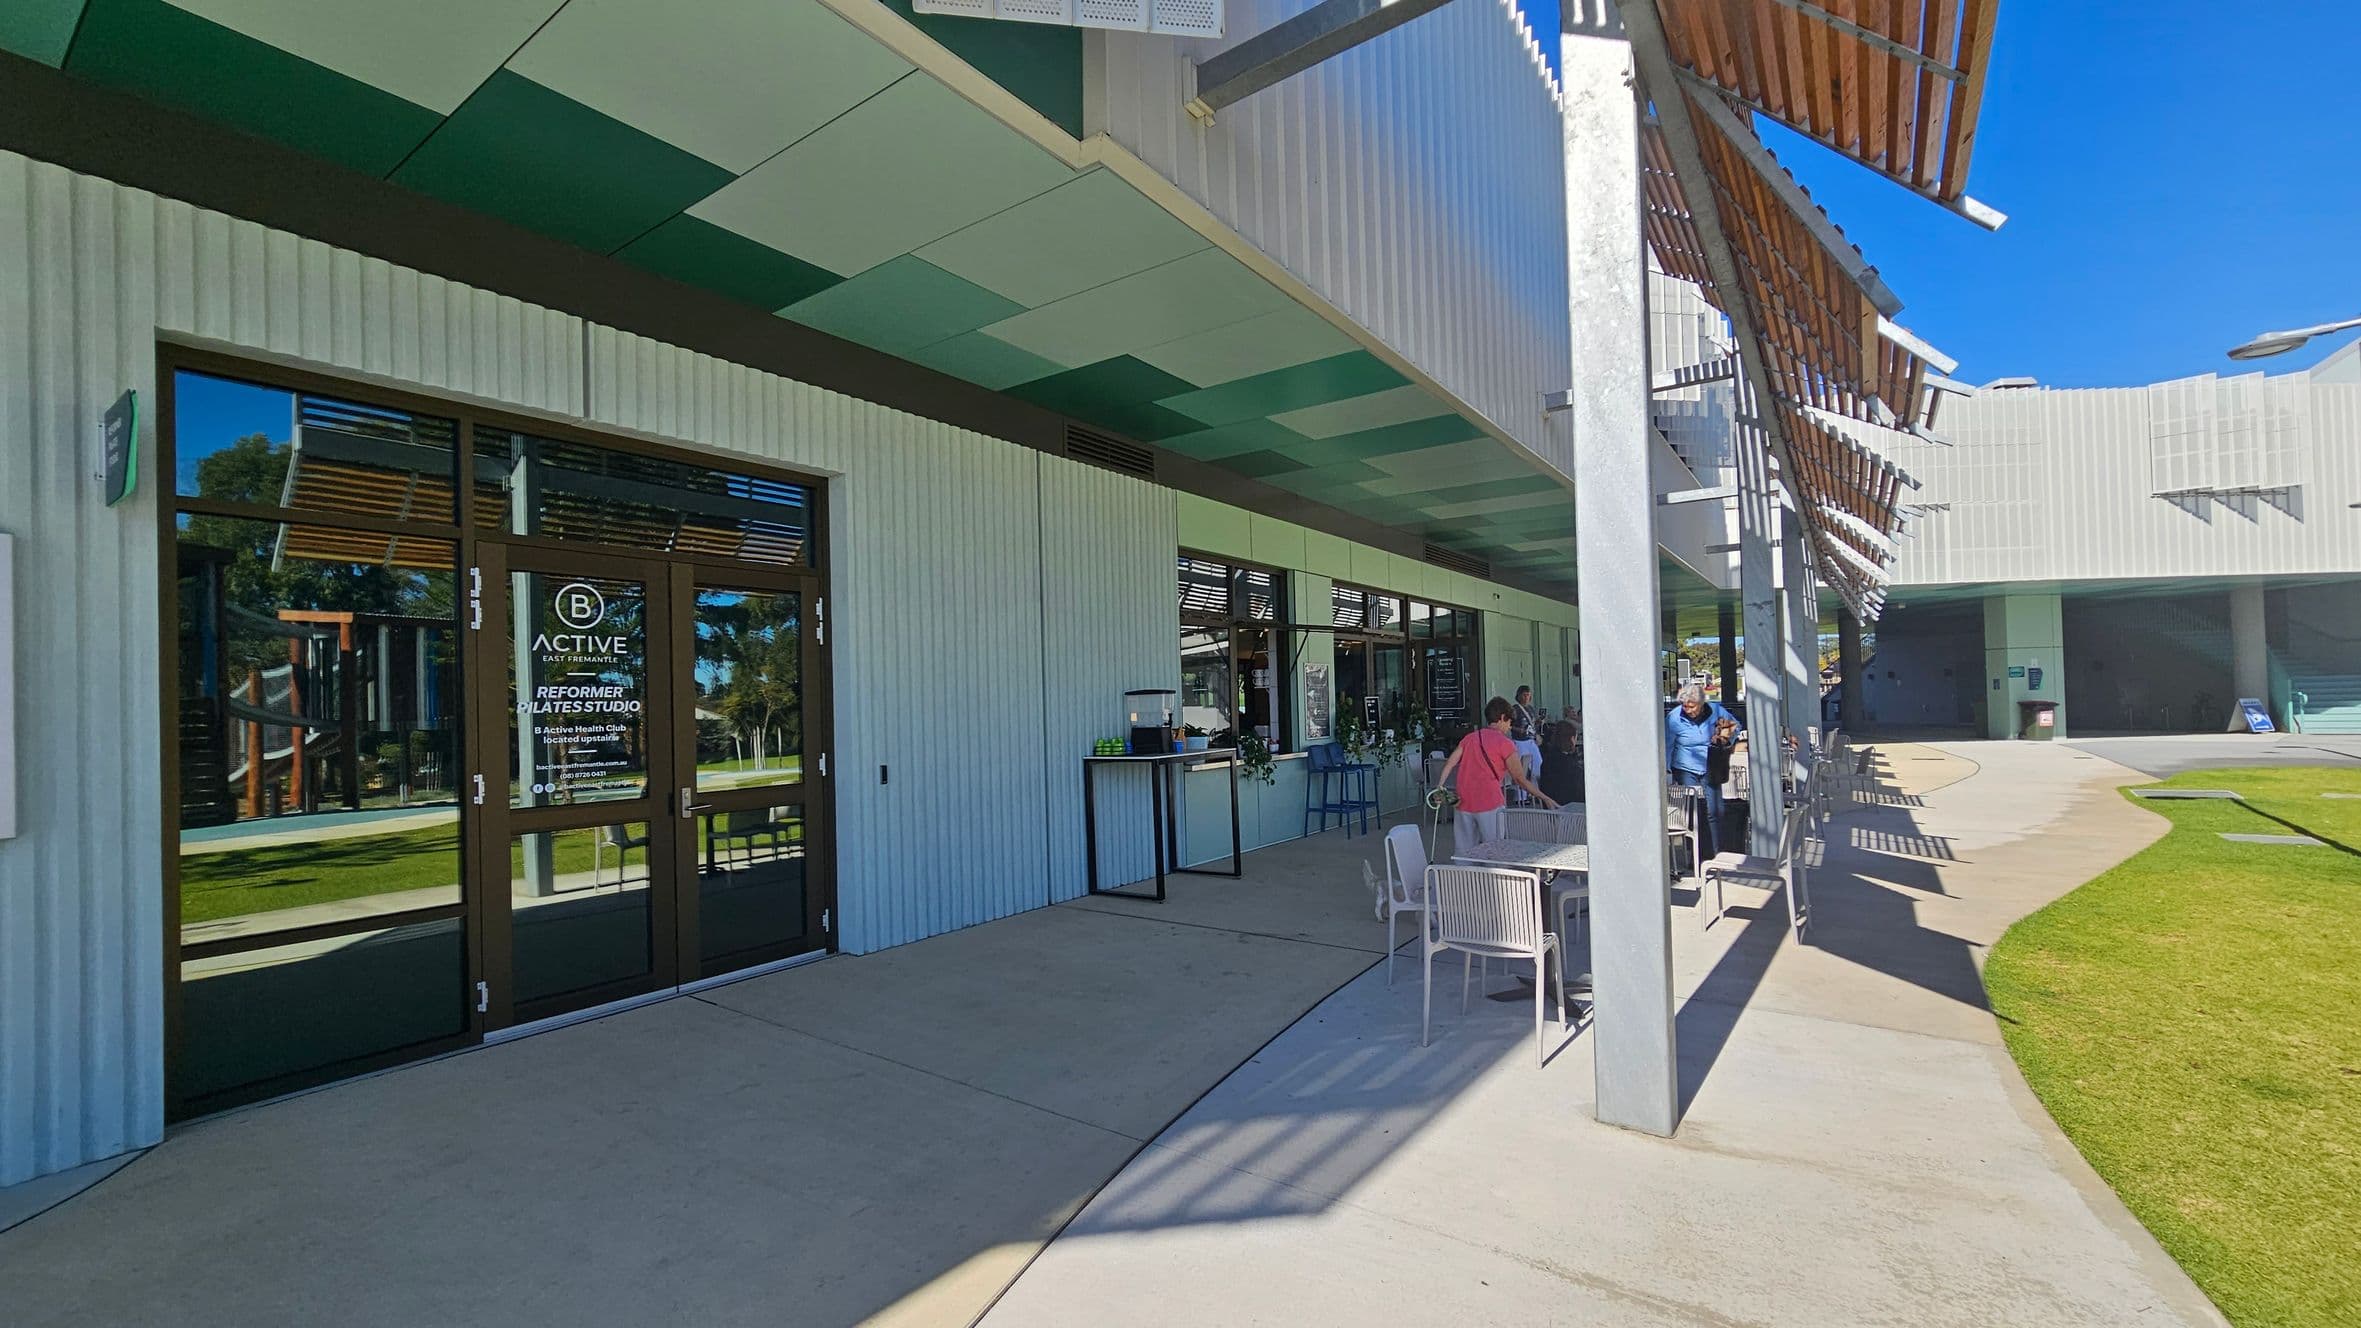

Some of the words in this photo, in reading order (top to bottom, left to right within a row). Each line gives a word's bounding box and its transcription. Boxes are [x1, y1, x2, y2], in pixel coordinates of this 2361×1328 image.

[572, 594, 591, 618] B
[532, 634, 628, 653] ACTIVE
[567, 655, 618, 663] FREMANTLE
[537, 686, 624, 698] REFORMER
[516, 701, 582, 713] PILATES
[583, 700, 641, 712] STUDIO
[543, 726, 574, 734] Active
[575, 725, 604, 733] Health
[606, 724, 627, 732] Club
[543, 734, 580, 744] located
[536, 760, 628, 771] bactiveeastfremantle.com.au
